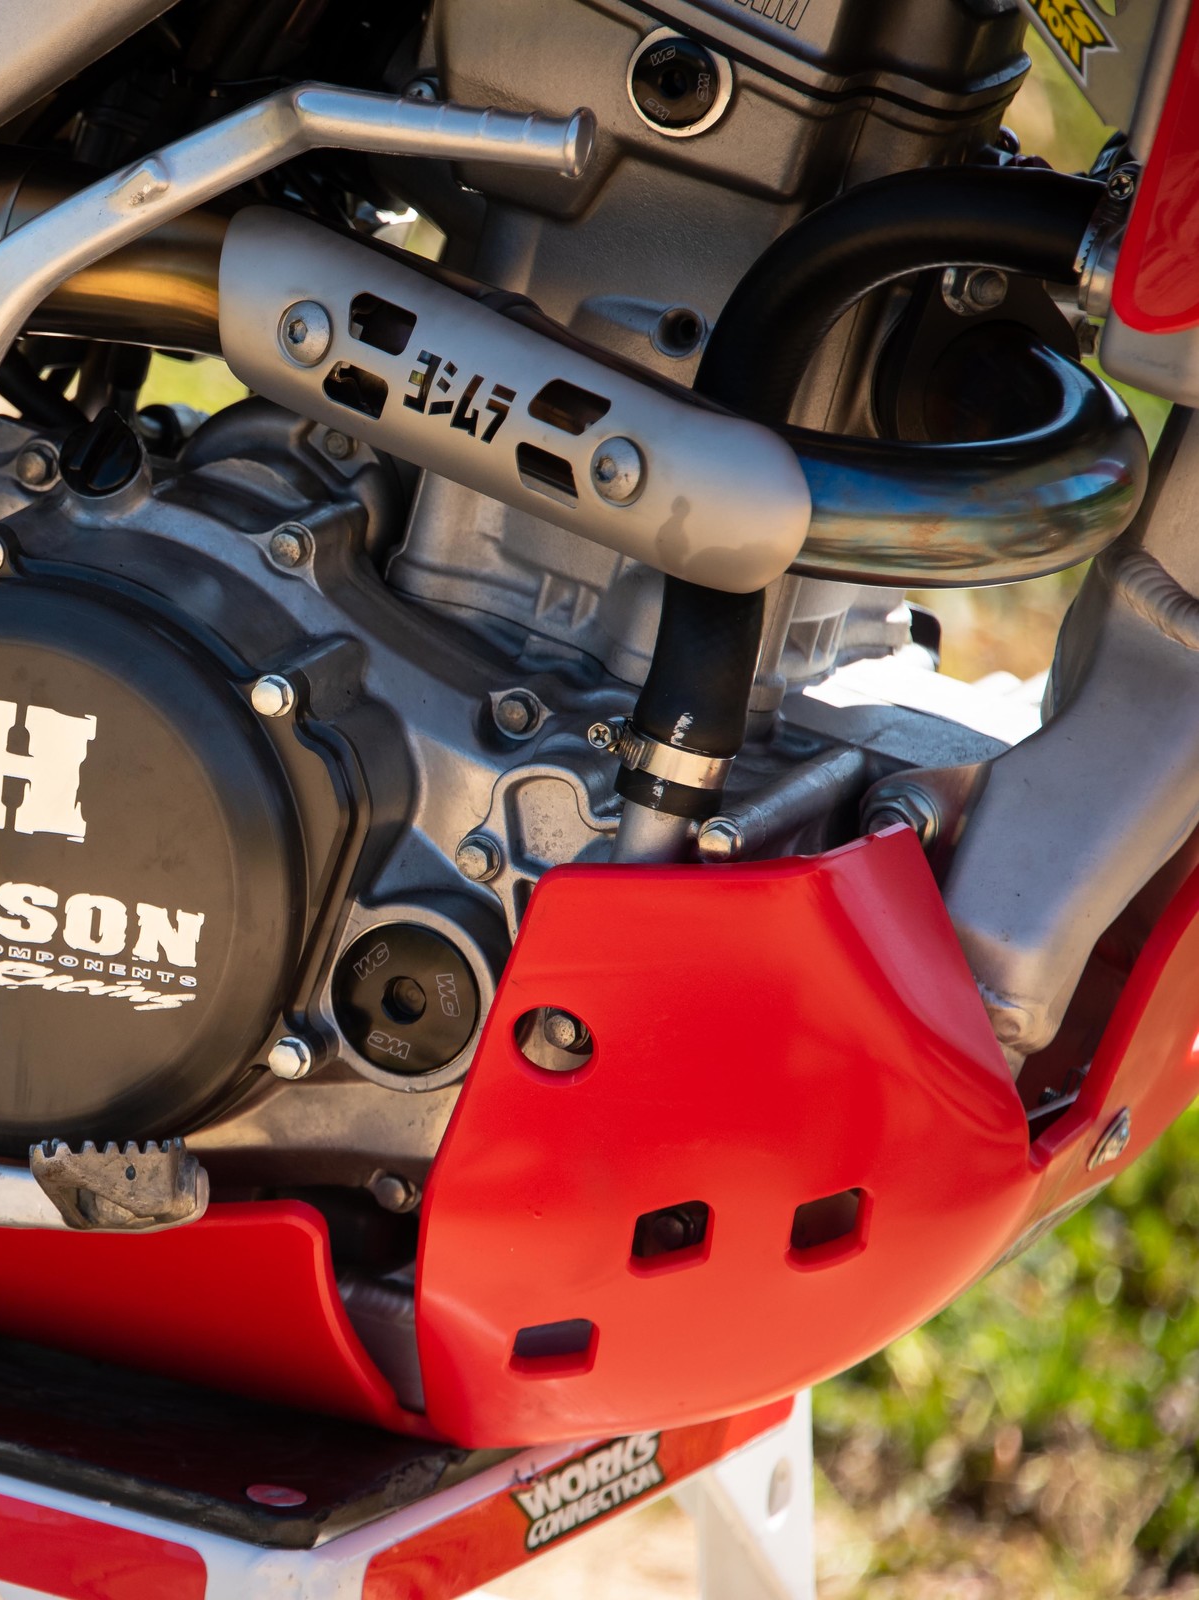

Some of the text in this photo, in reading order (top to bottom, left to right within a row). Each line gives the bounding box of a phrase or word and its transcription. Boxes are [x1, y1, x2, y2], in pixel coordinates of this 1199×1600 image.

[403, 349, 517, 444] ヨシムラ
[353, 941, 390, 981] WC
[435, 973, 461, 1018] WC
[516, 1430, 661, 1520] WORKS
[526, 1460, 664, 1549] CONNECTION
